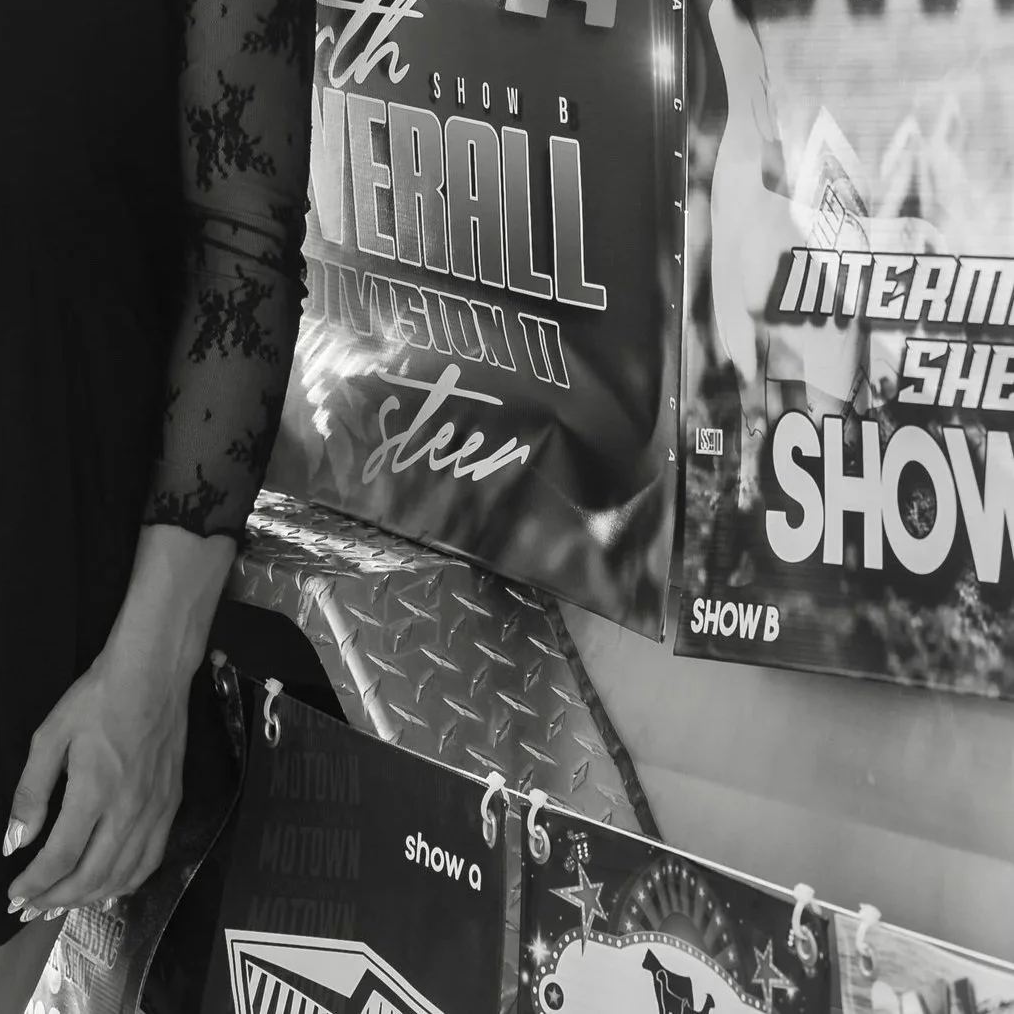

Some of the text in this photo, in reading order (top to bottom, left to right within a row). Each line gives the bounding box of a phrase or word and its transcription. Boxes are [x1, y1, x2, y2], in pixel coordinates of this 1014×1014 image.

[433, 72, 570, 125] SHOW B
[309, 84, 607, 310] VERALL
[779, 247, 1014, 326] INTERM
[690, 598, 780, 642] SHOW B
[404, 832, 482, 891] show a
